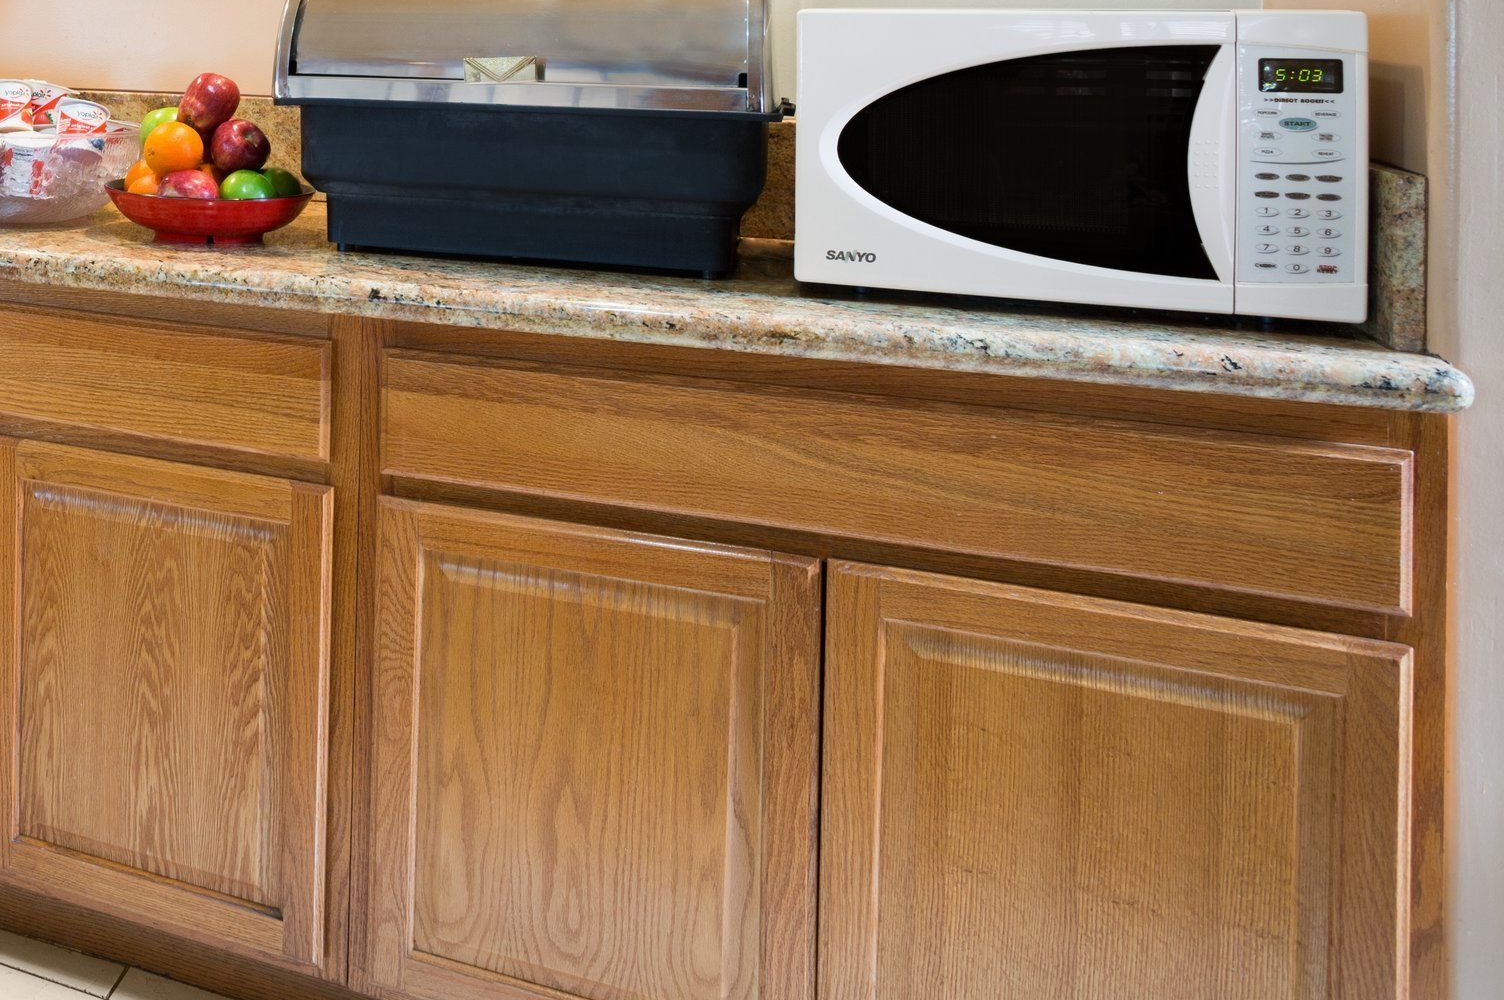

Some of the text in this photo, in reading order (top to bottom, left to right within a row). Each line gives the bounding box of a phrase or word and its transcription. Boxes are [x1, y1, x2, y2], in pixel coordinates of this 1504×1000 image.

[1275, 68, 1323, 82] 5:03
[1294, 208, 1301, 216] 2
[1324, 228, 1332, 236] 6
[1293, 245, 1300, 253] 8
[825, 249, 877, 263] SANYO
[1292, 263, 1300, 271] 0
